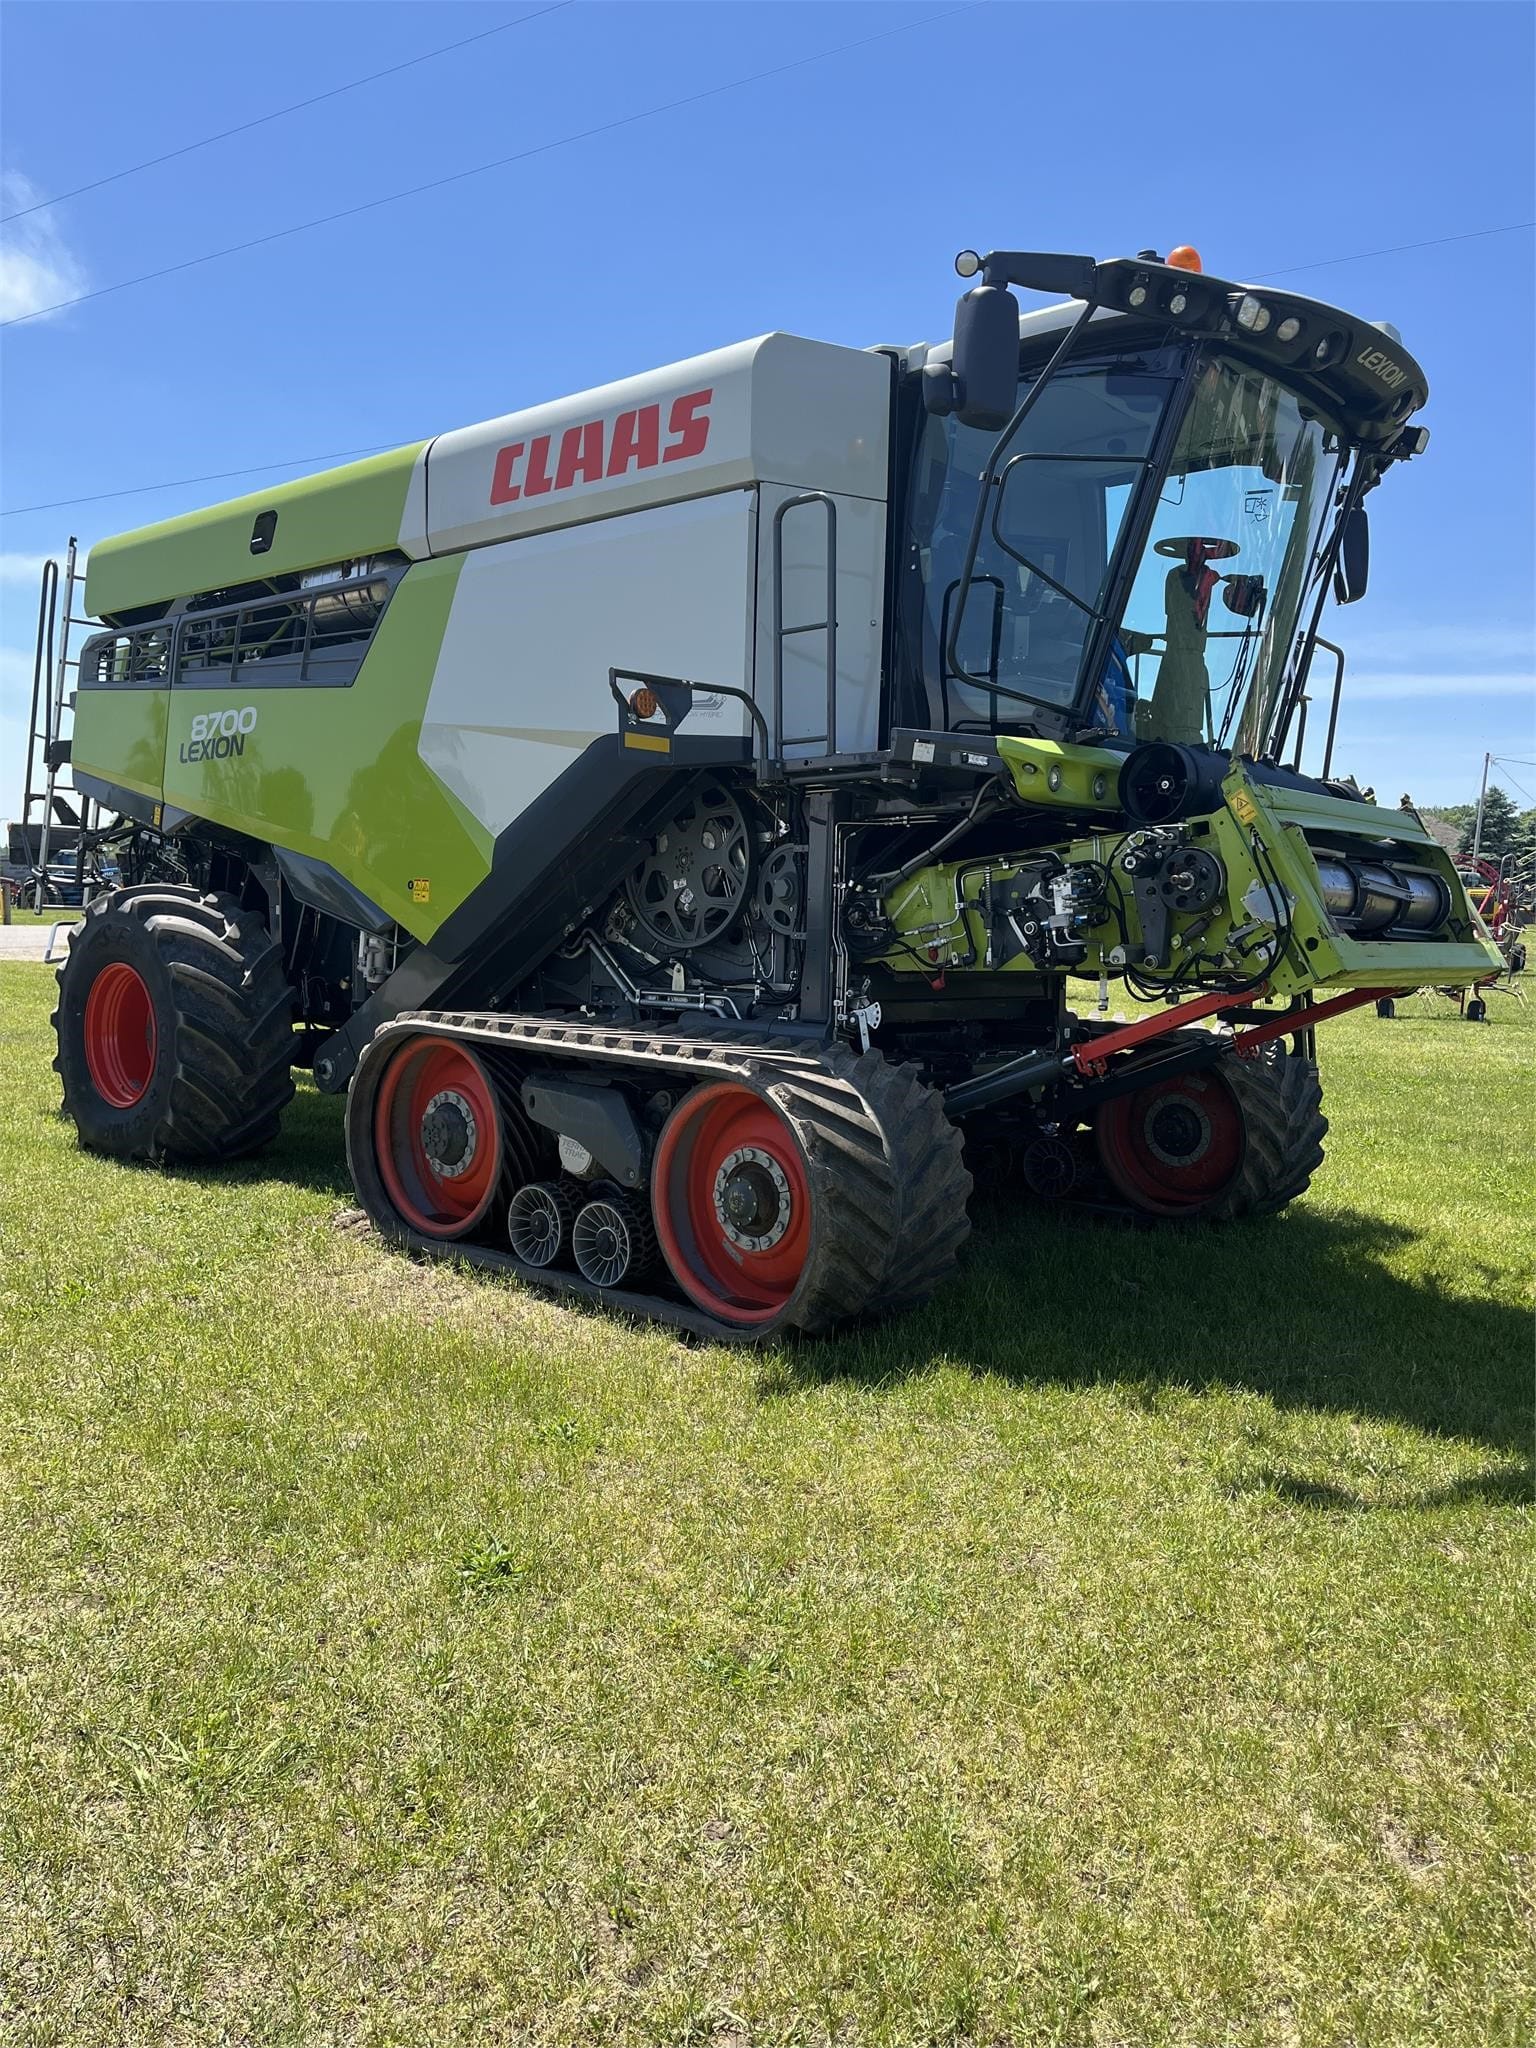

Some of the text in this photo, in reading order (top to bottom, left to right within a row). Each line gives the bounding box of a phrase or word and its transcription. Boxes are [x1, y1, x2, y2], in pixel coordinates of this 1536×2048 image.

[1357, 346, 1408, 389] LEXION
[490, 388, 713, 506] CLAAS
[191, 706, 257, 742] 8700
[180, 734, 245, 764] LEXION
